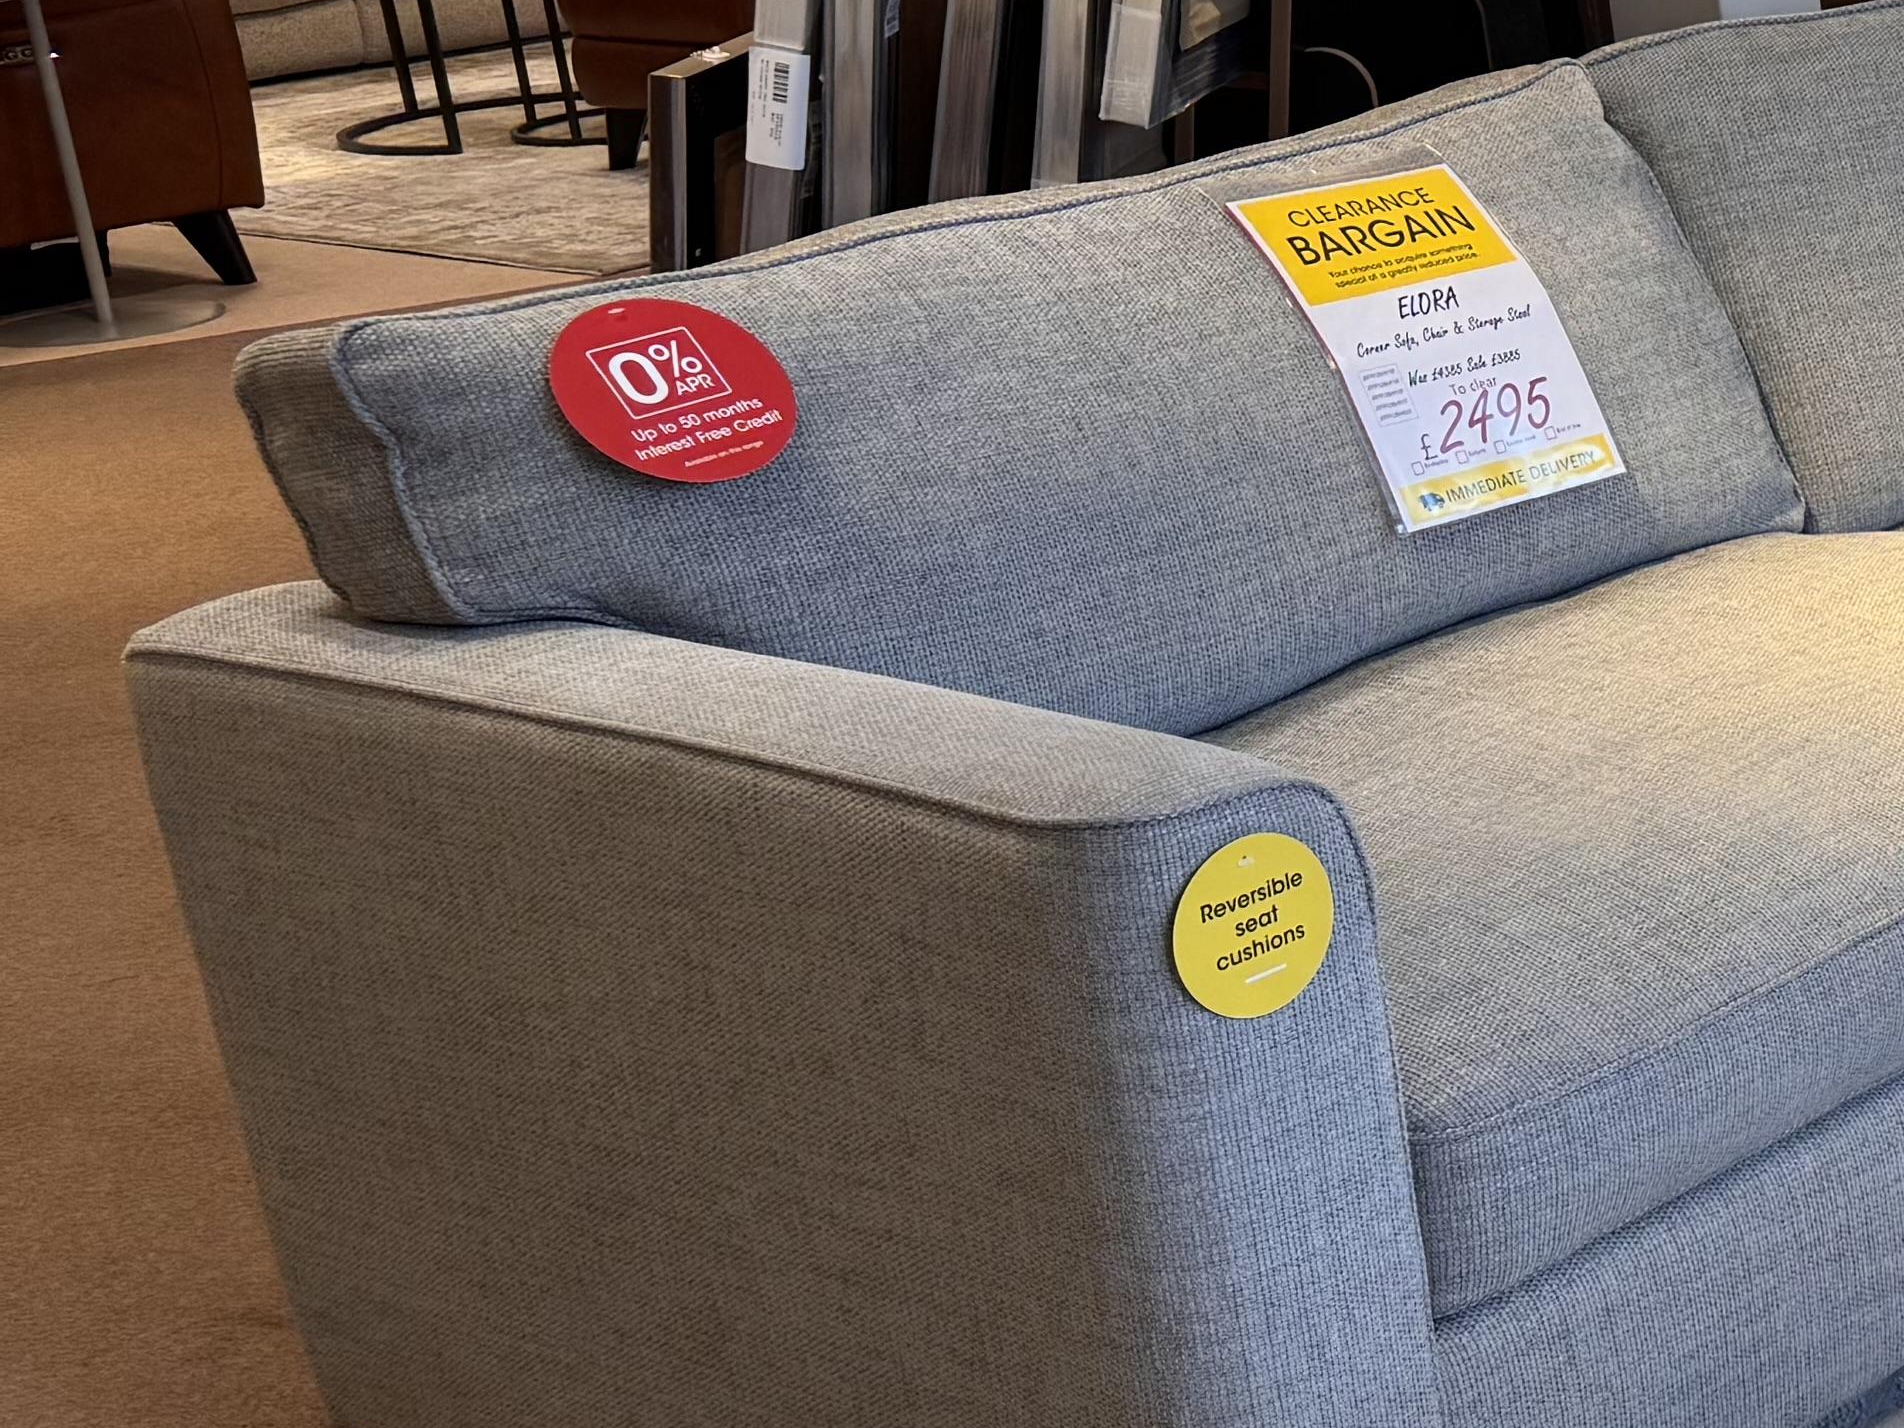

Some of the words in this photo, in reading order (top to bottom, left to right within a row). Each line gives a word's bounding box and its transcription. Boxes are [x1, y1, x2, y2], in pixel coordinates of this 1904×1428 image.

[1287, 187, 1435, 227] CLEARANCE
[1286, 205, 1476, 266] BARGAIN
[1328, 269, 1348, 279] Your
[1350, 262, 1383, 276] chance
[1384, 259, 1394, 269] to
[1428, 243, 1473, 259] something
[1388, 264, 1418, 279] greatly
[1398, 285, 1459, 320] ELORA
[1356, 341, 1391, 358] Corner
[1422, 325, 1449, 342] Chair
[1453, 320, 1464, 334] &
[1468, 315, 1504, 331] Storage
[1507, 303, 1531, 322] Stool
[608, 339, 703, 405] 0%
[675, 373, 715, 396] APR
[1408, 370, 1428, 388] Was
[1467, 354, 1487, 373] Sale
[1448, 383, 1467, 396] To
[1471, 376, 1497, 392] clear
[631, 428, 658, 443] Up
[658, 422, 677, 435] to
[678, 413, 701, 429] 50
[702, 398, 763, 423] months
[634, 435, 696, 461] Interest
[695, 427, 732, 444] Free
[733, 409, 783, 432] Credit
[1445, 469, 1527, 504] IMMEDIATE
[1529, 449, 1597, 481] DELIVERY
[1200, 872, 1303, 924] Reversible
[1235, 904, 1279, 937] seat
[1216, 924, 1305, 971] cushions
